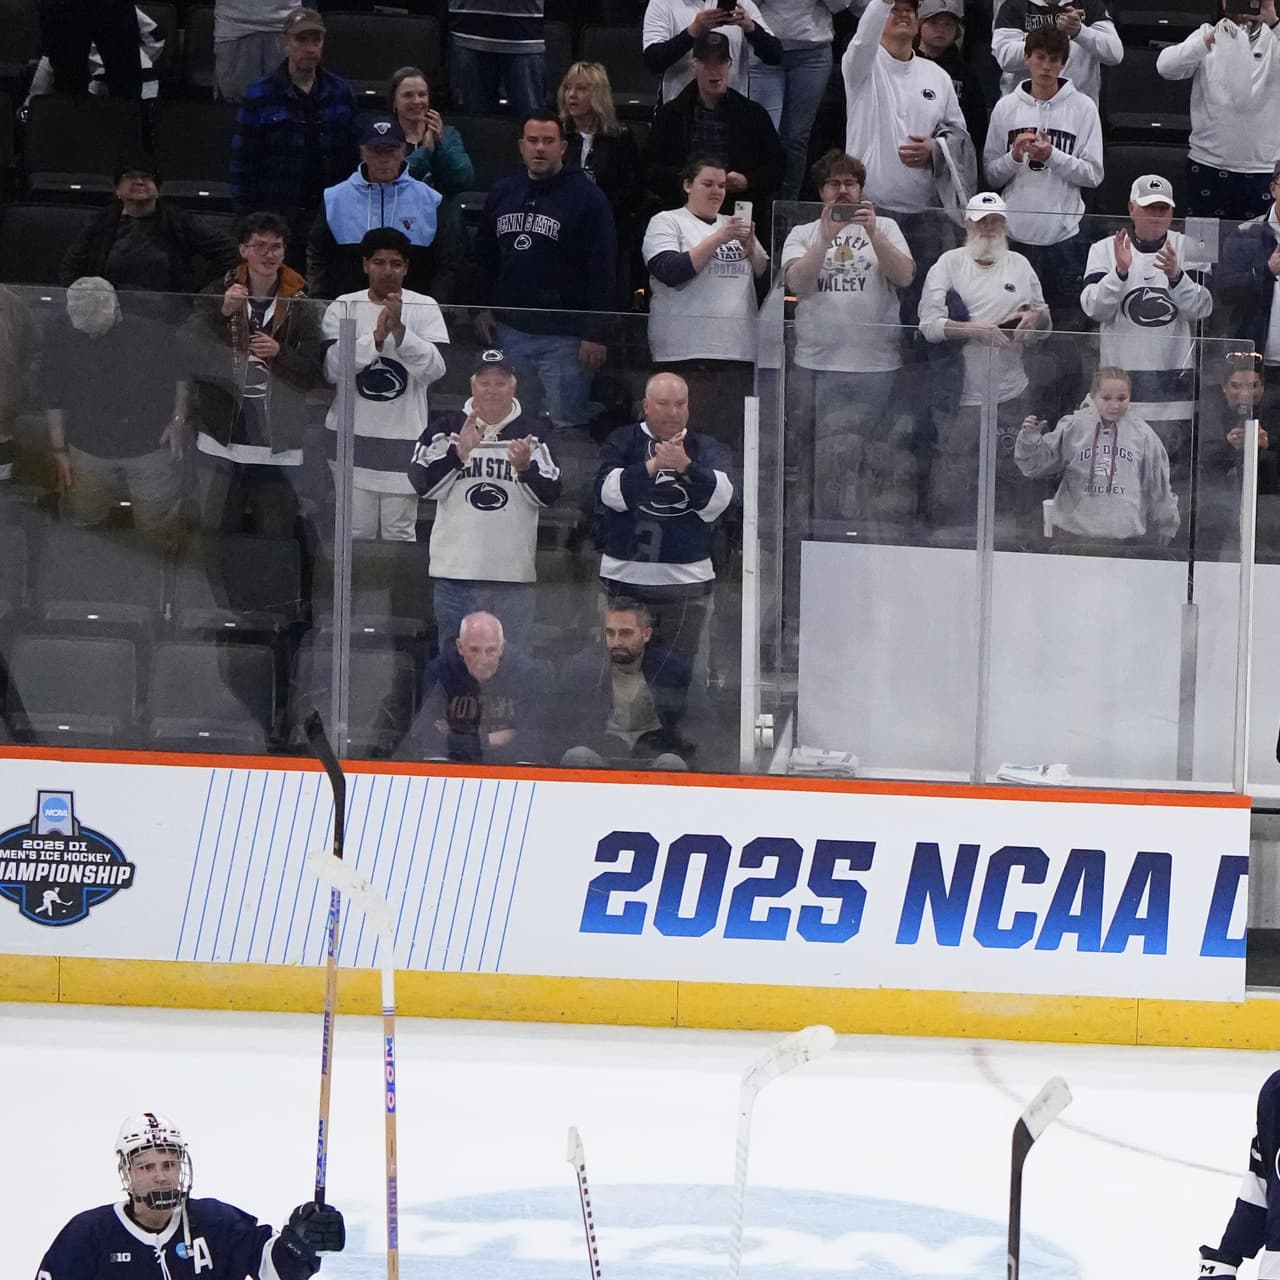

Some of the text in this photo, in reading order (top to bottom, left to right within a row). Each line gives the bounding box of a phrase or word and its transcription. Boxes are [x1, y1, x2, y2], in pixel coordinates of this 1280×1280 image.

[817, 277, 866, 292] VALLEY
[45, 809, 68, 817] NCAA
[22, 840, 65, 850] 2025
[0, 850, 111, 862] MEN'S ICE HOCKEY
[579, 831, 877, 943] 2025
[895, 842, 1173, 955] NCAA
[384, 1037, 396, 1113] CCM
[193, 1237, 213, 1275] A
